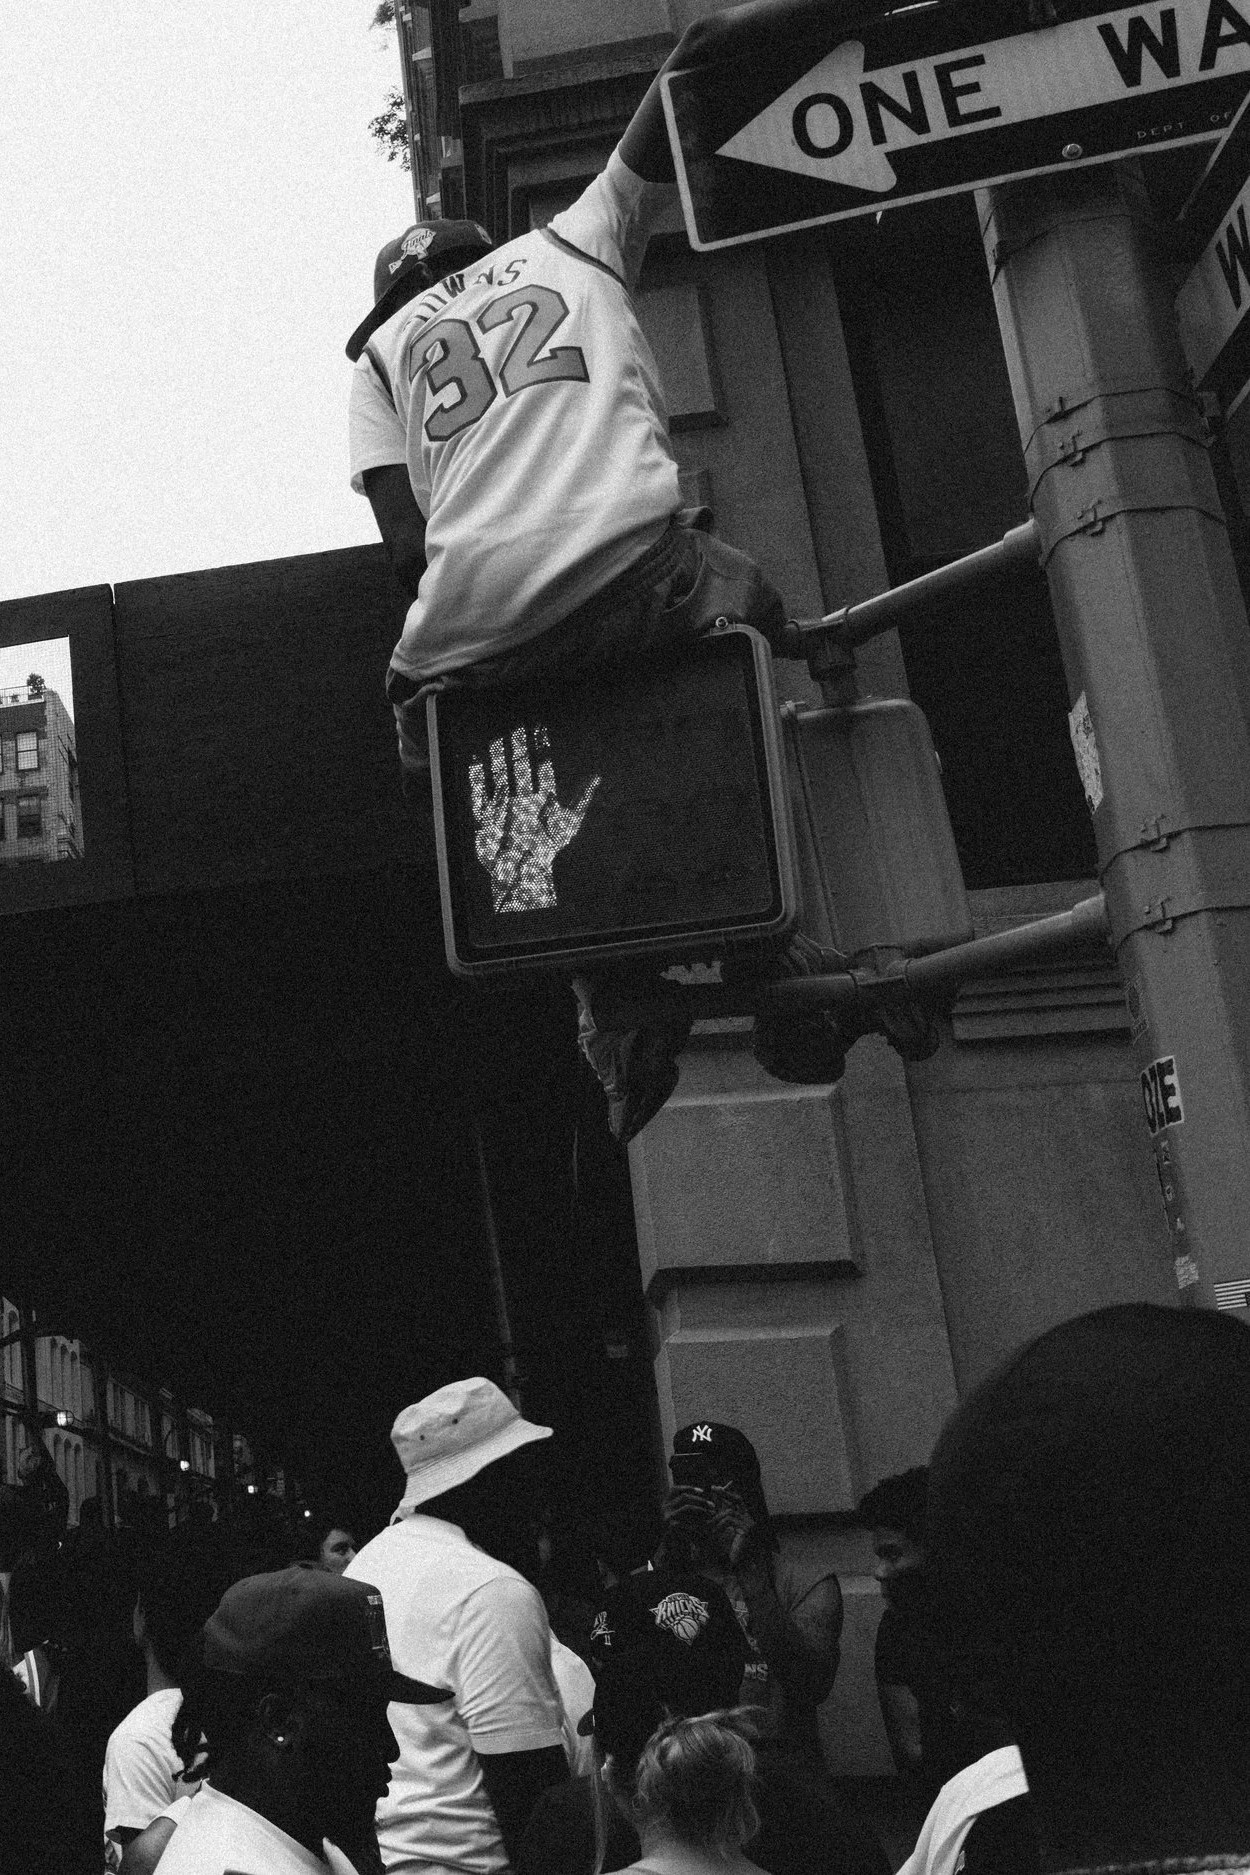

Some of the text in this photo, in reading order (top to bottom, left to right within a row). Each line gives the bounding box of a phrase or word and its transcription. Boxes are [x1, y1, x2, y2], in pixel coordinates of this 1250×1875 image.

[791, 54, 1002, 159] ONE
[1136, 122, 1185, 139] DEPT
[410, 284, 590, 441] 32
[692, 1424, 713, 1443] NY
[656, 1599, 710, 1625] KNICKS
